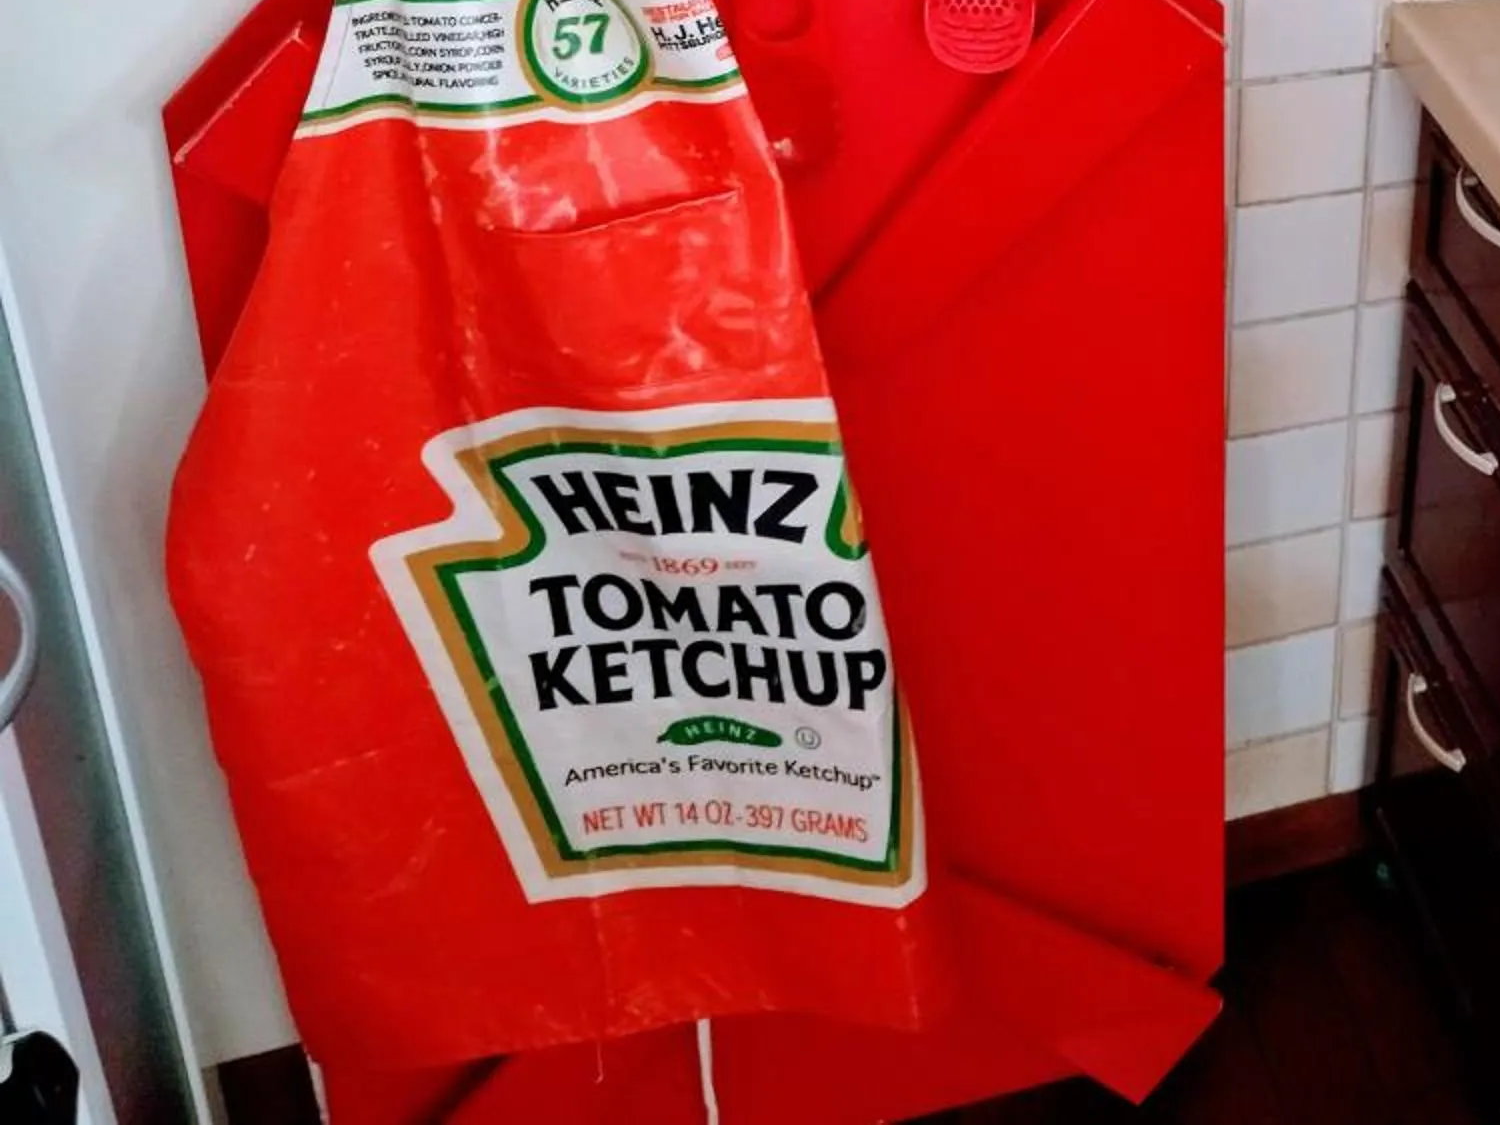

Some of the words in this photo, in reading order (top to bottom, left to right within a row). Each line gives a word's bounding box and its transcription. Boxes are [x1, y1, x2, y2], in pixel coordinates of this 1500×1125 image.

[552, 13, 611, 60] 57
[674, 24, 694, 40] J.
[554, 55, 635, 89] VARIETIES
[530, 468, 819, 544] HEINZ
[651, 556, 719, 575] 1869
[529, 573, 867, 640] TOMATO
[528, 638, 887, 711] KETCHUP
[684, 721, 758, 742] HEINZ
[564, 756, 681, 787] America's
[687, 754, 779, 776] Favorite
[581, 804, 626, 835] NET
[632, 802, 668, 827] WT
[674, 801, 699, 824] 14
[790, 807, 869, 843] GRAMS
